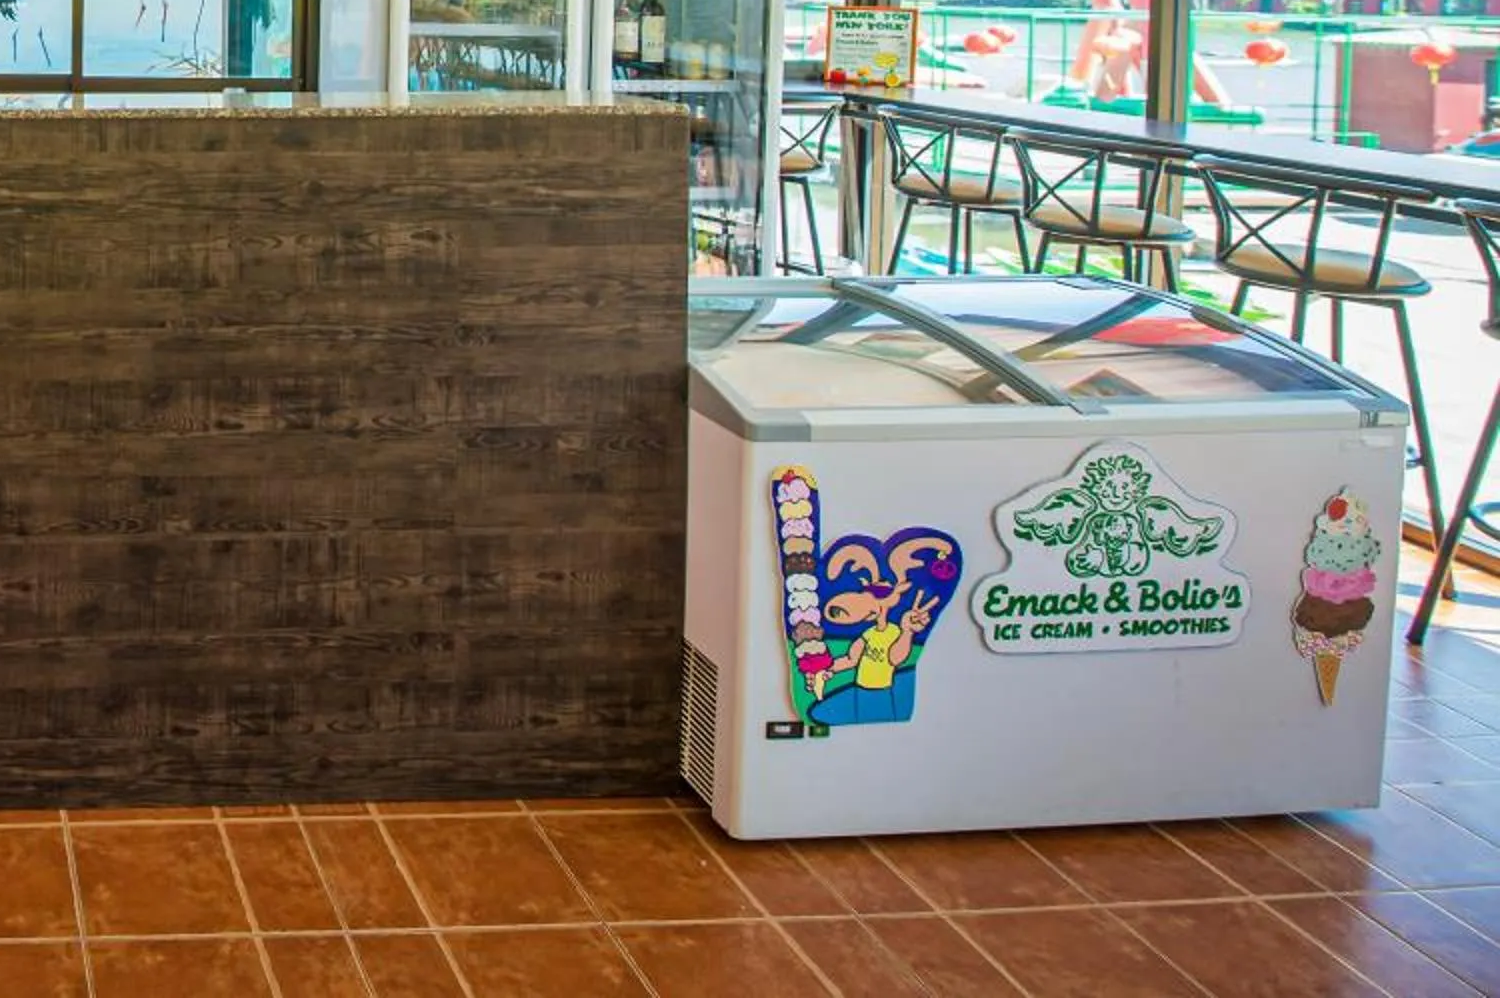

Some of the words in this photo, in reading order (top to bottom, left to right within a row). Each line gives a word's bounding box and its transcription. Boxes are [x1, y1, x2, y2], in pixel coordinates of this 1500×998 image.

[983, 582, 1100, 618] Emack
[1103, 580, 1134, 615] &
[1137, 578, 1243, 614] Bolio's
[993, 623, 1023, 641] ICE
[1030, 621, 1093, 640] CREAM
[1118, 616, 1231, 637] SMOOTHIES
